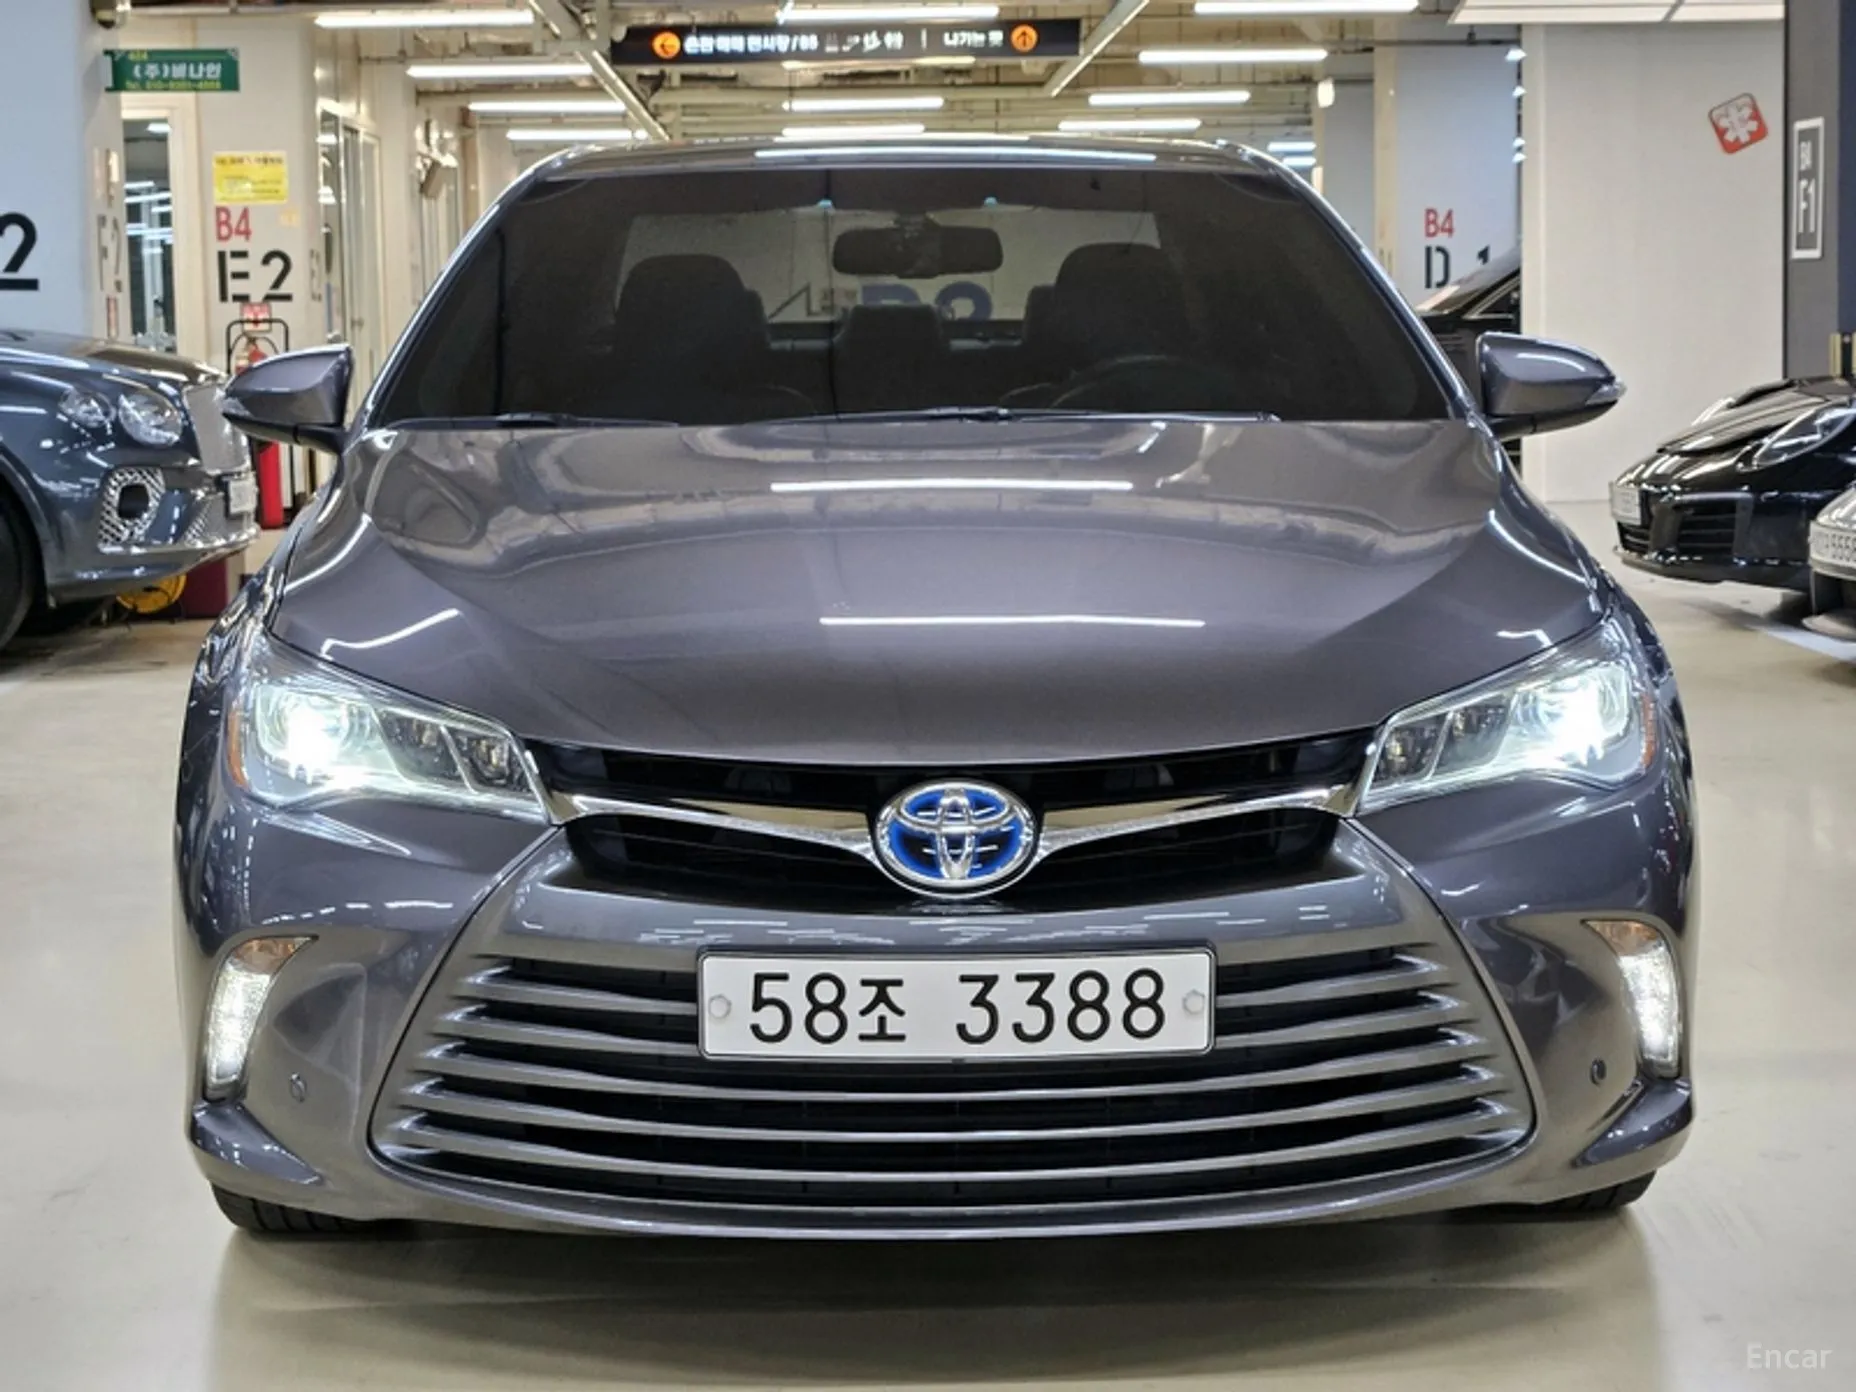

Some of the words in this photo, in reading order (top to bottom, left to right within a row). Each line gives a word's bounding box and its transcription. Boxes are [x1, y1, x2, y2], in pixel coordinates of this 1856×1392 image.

[215, 206, 252, 241] B4
[1425, 208, 1454, 238] B4
[217, 249, 293, 302] E2
[749, 971, 906, 1045] 58조
[956, 967, 1166, 1045] 3388
